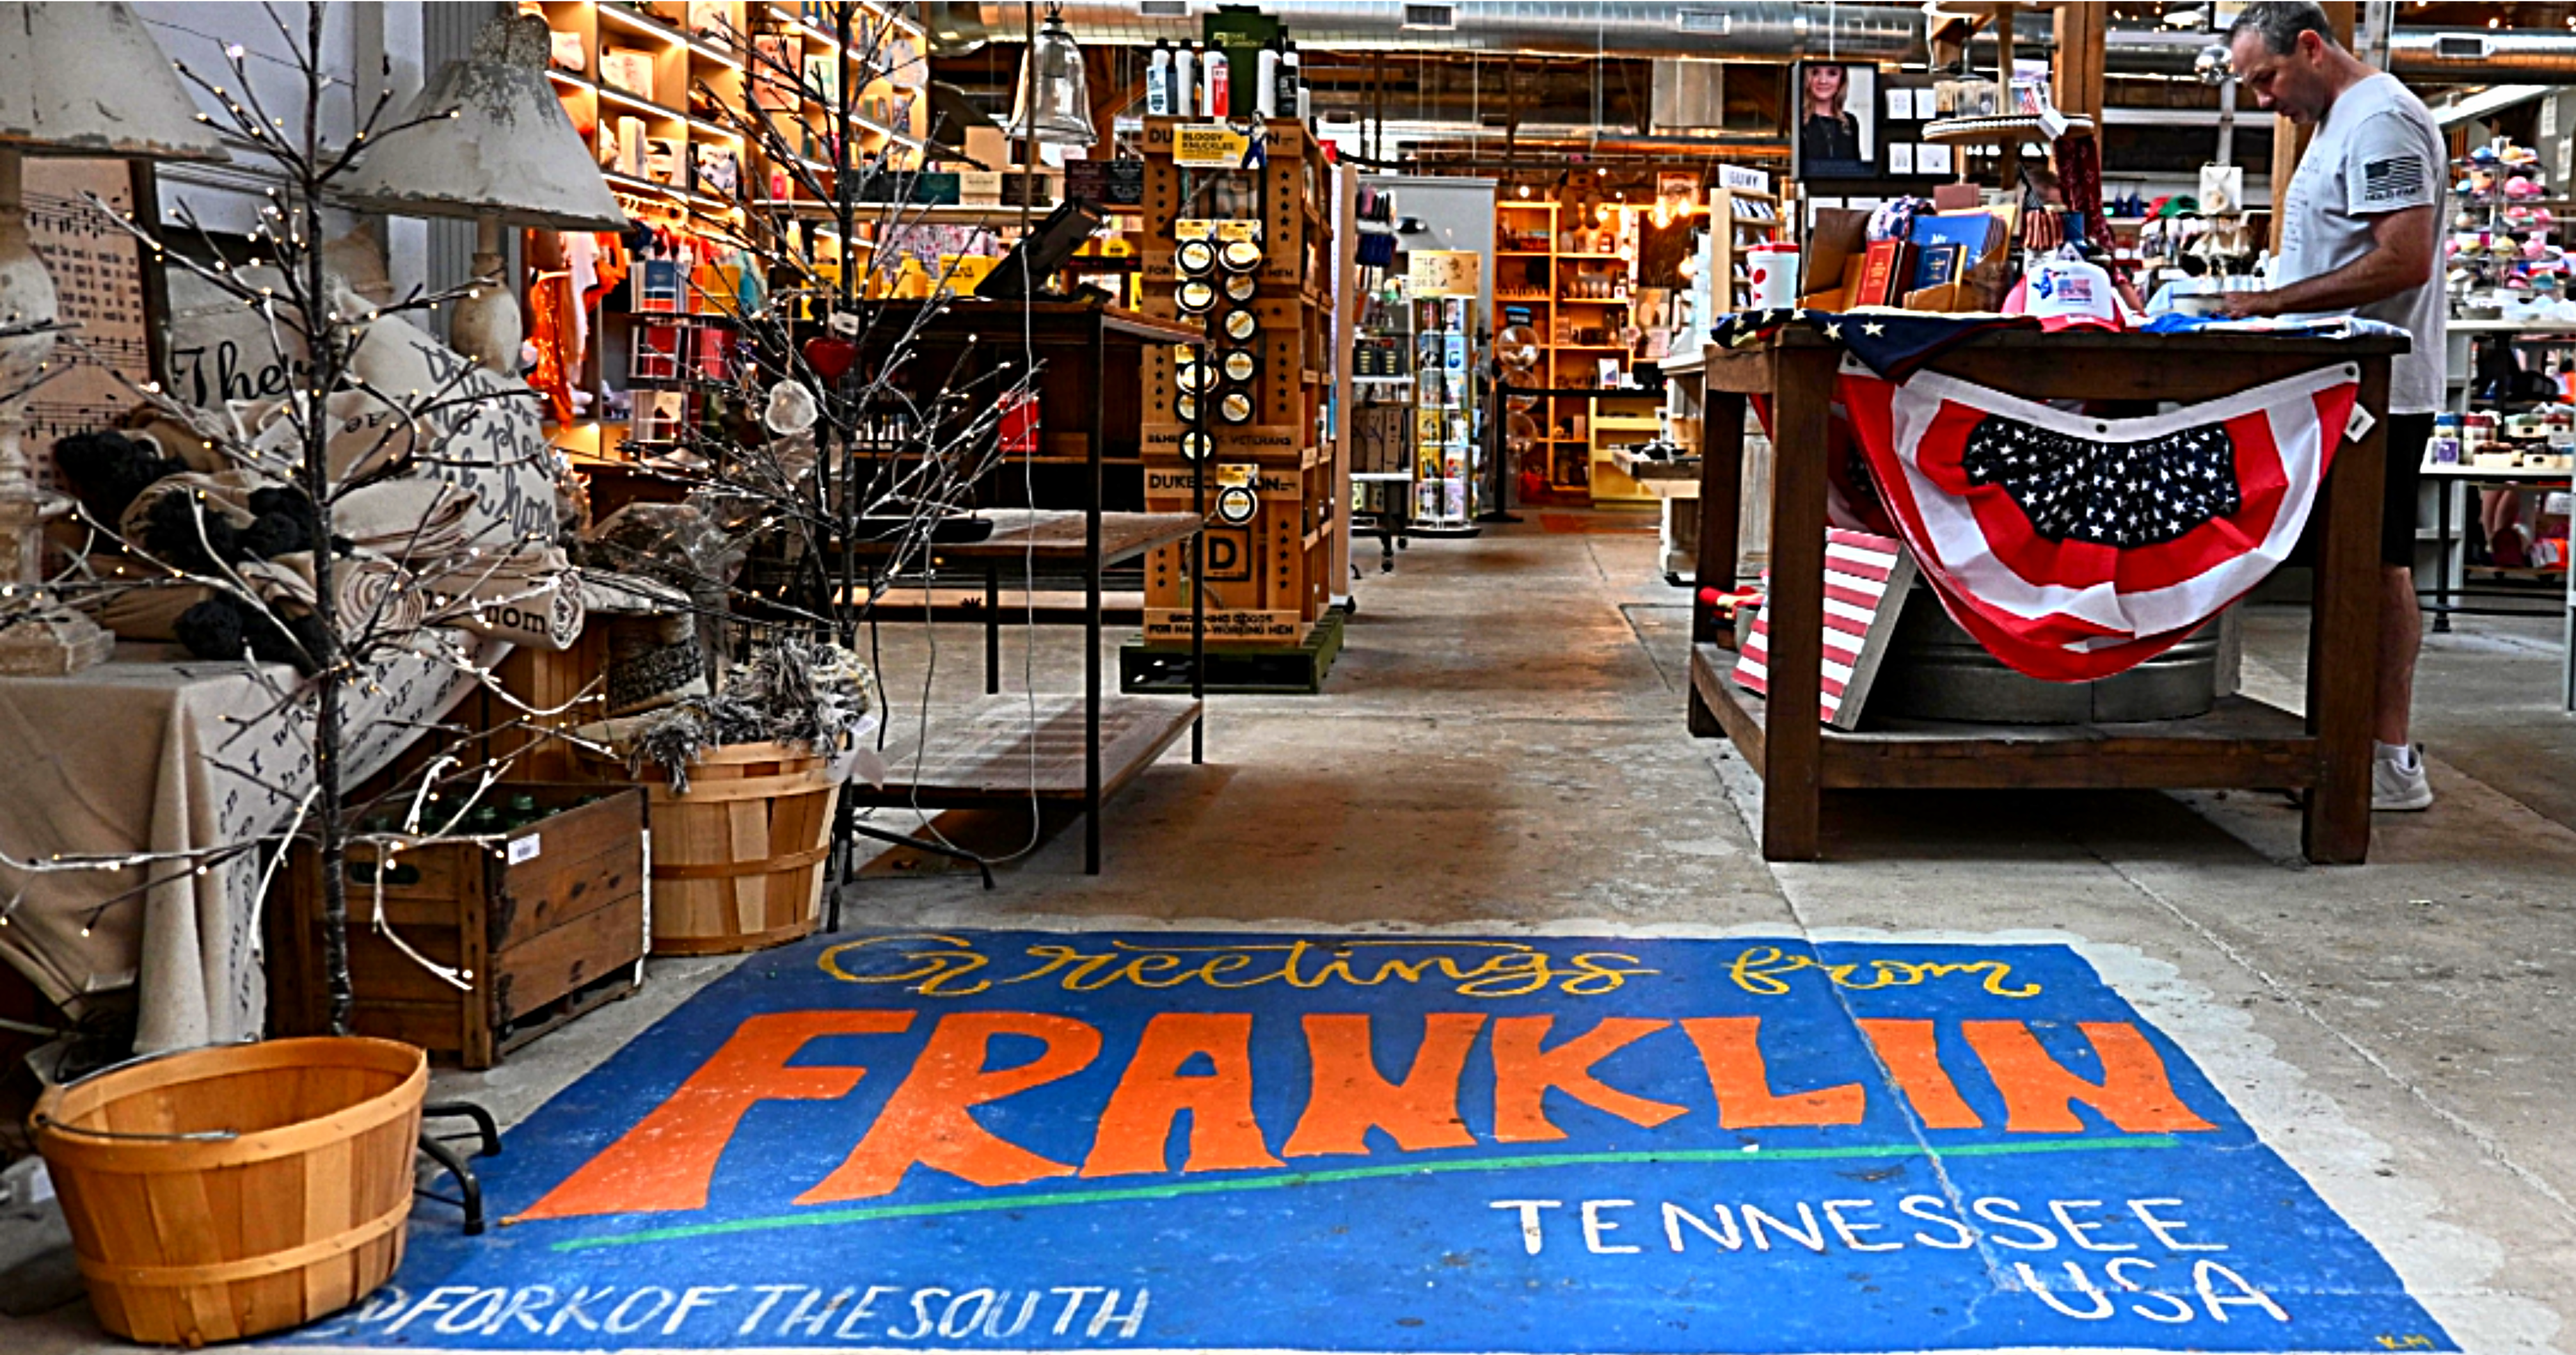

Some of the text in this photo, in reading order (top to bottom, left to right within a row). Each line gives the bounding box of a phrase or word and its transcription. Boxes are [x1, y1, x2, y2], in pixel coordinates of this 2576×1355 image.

[1150, 475, 1195, 489] DUKE
[1209, 537, 1237, 570] D
[1148, 624, 1294, 635] FOR HA-WORKING MEN
[1168, 613, 1231, 624] GROING
[818, 935, 2042, 999] Greetings from
[499, 1010, 2220, 1226] FRANKLIN
[1489, 1197, 2229, 1256] TENNESSEE
[2012, 1260, 2292, 1325] USA
